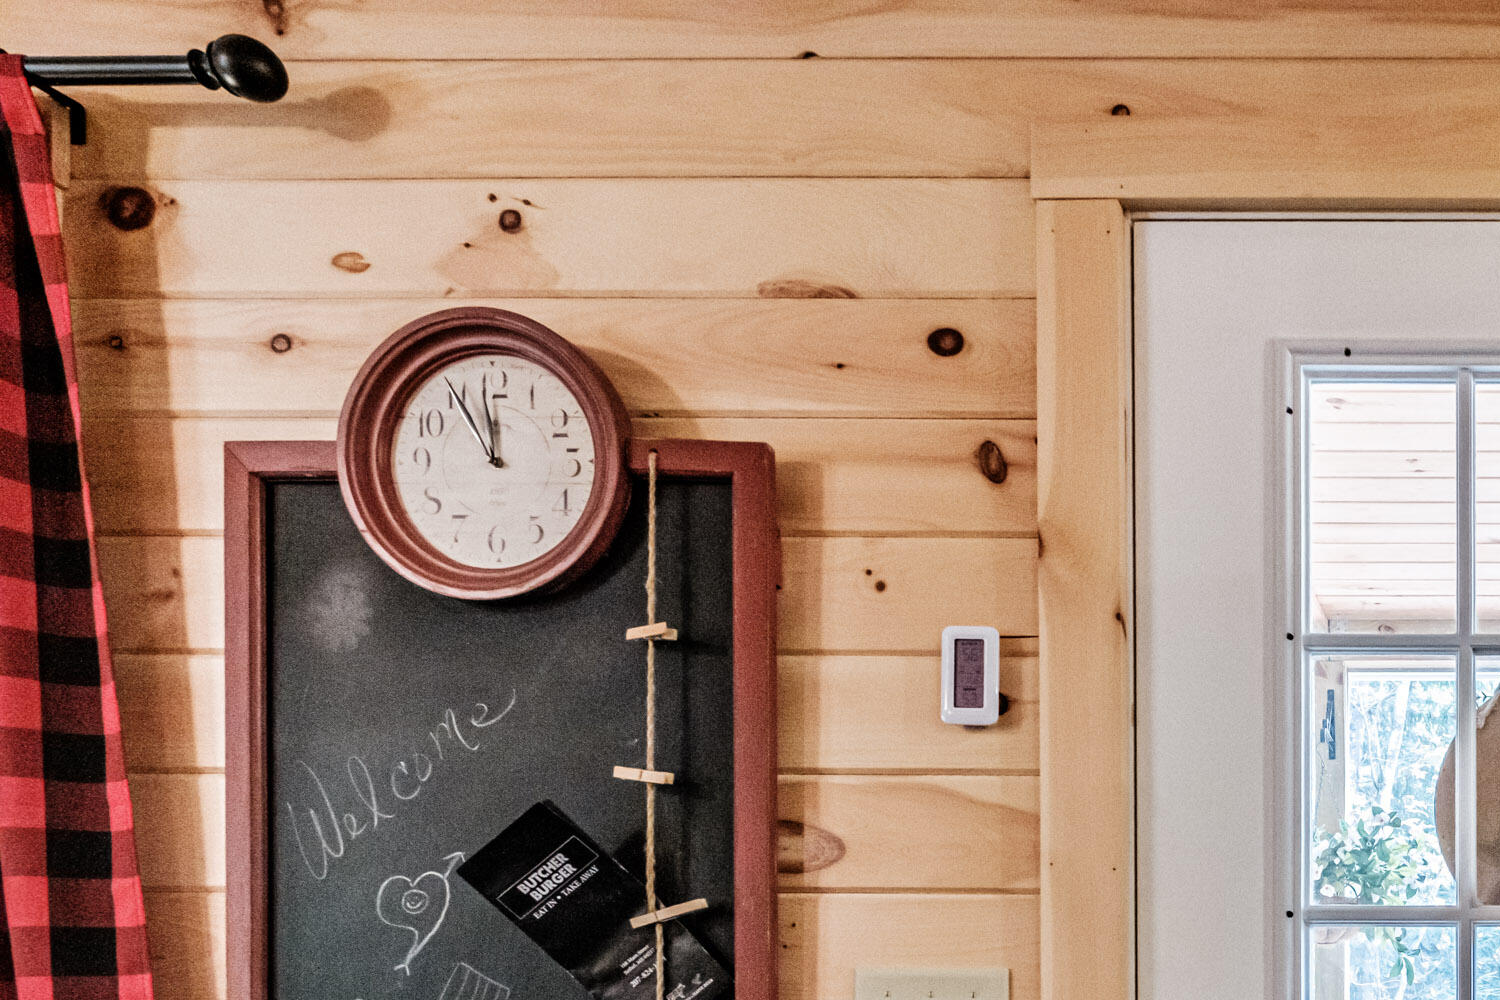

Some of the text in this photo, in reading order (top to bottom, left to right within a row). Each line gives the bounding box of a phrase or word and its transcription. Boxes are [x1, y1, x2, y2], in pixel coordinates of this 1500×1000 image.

[482, 370, 508, 399] 12
[530, 383, 535, 410] 1
[419, 408, 445, 438] 10
[551, 408, 569, 438] 2
[413, 447, 431, 476] 9
[422, 487, 442, 515] 8
[552, 488, 572, 517] 4
[451, 514, 469, 544] 7
[488, 524, 506, 554] 6
[528, 515, 545, 544] 5
[287, 688, 516, 880] Welcome
[517, 852, 569, 895] BUTCHER
[529, 863, 577, 902] BURGER
[532, 864, 600, 920] EAT IN TAKE AWAY
